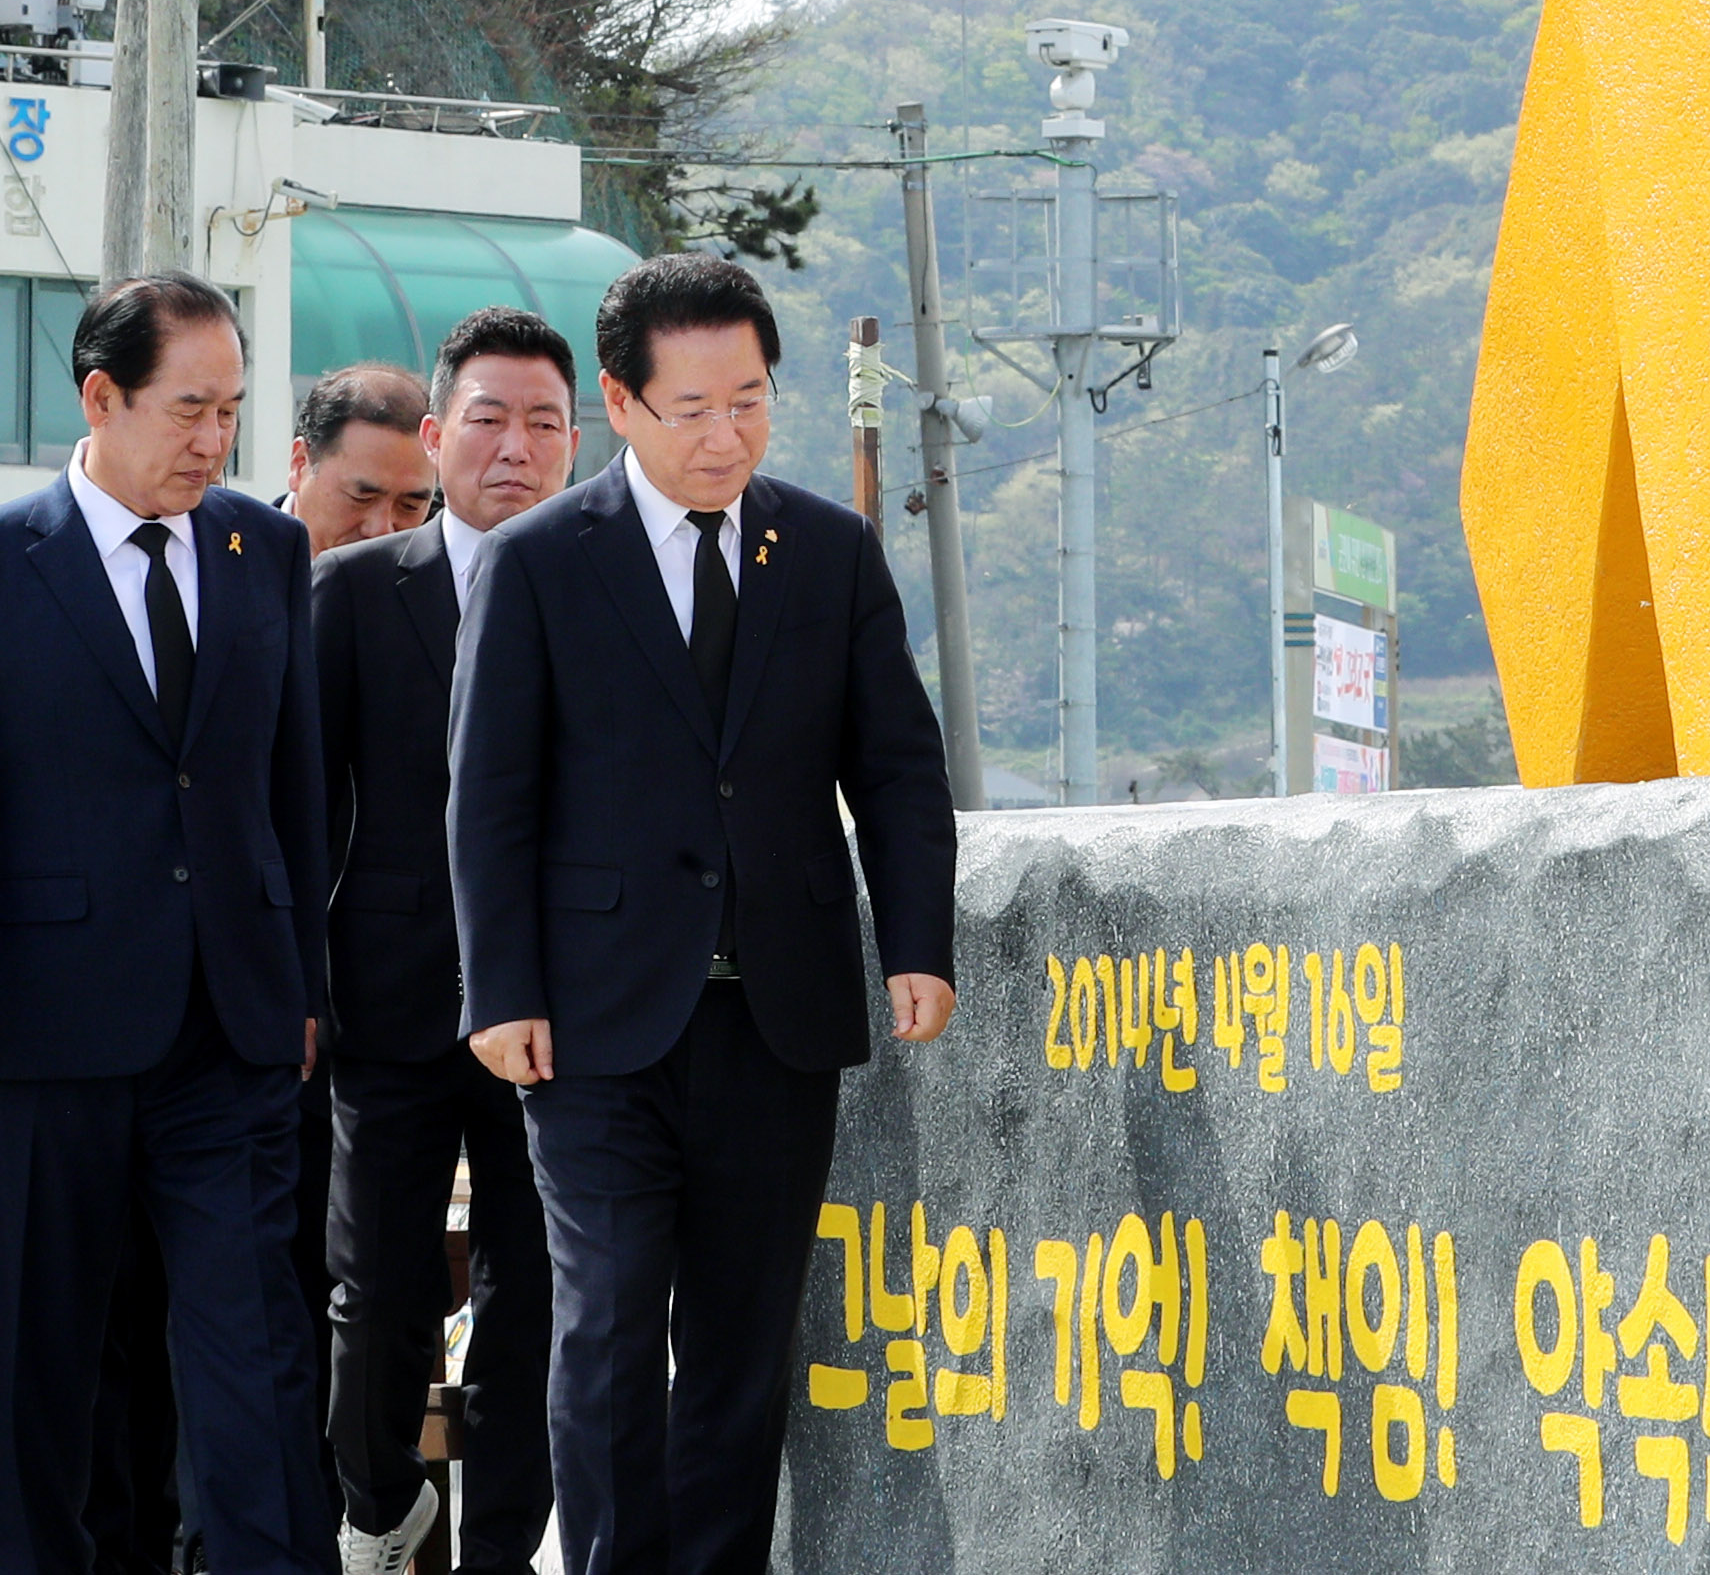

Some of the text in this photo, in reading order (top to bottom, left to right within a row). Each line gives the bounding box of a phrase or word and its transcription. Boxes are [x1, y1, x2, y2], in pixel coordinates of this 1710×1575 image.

[8, 96, 52, 162] 장
[1045, 942, 1404, 1093] 2014년 4월 16일
[808, 1201, 1008, 1451] 그날의
[1034, 1210, 1208, 1480] 기억!
[1261, 1210, 1458, 1502] 책임!
